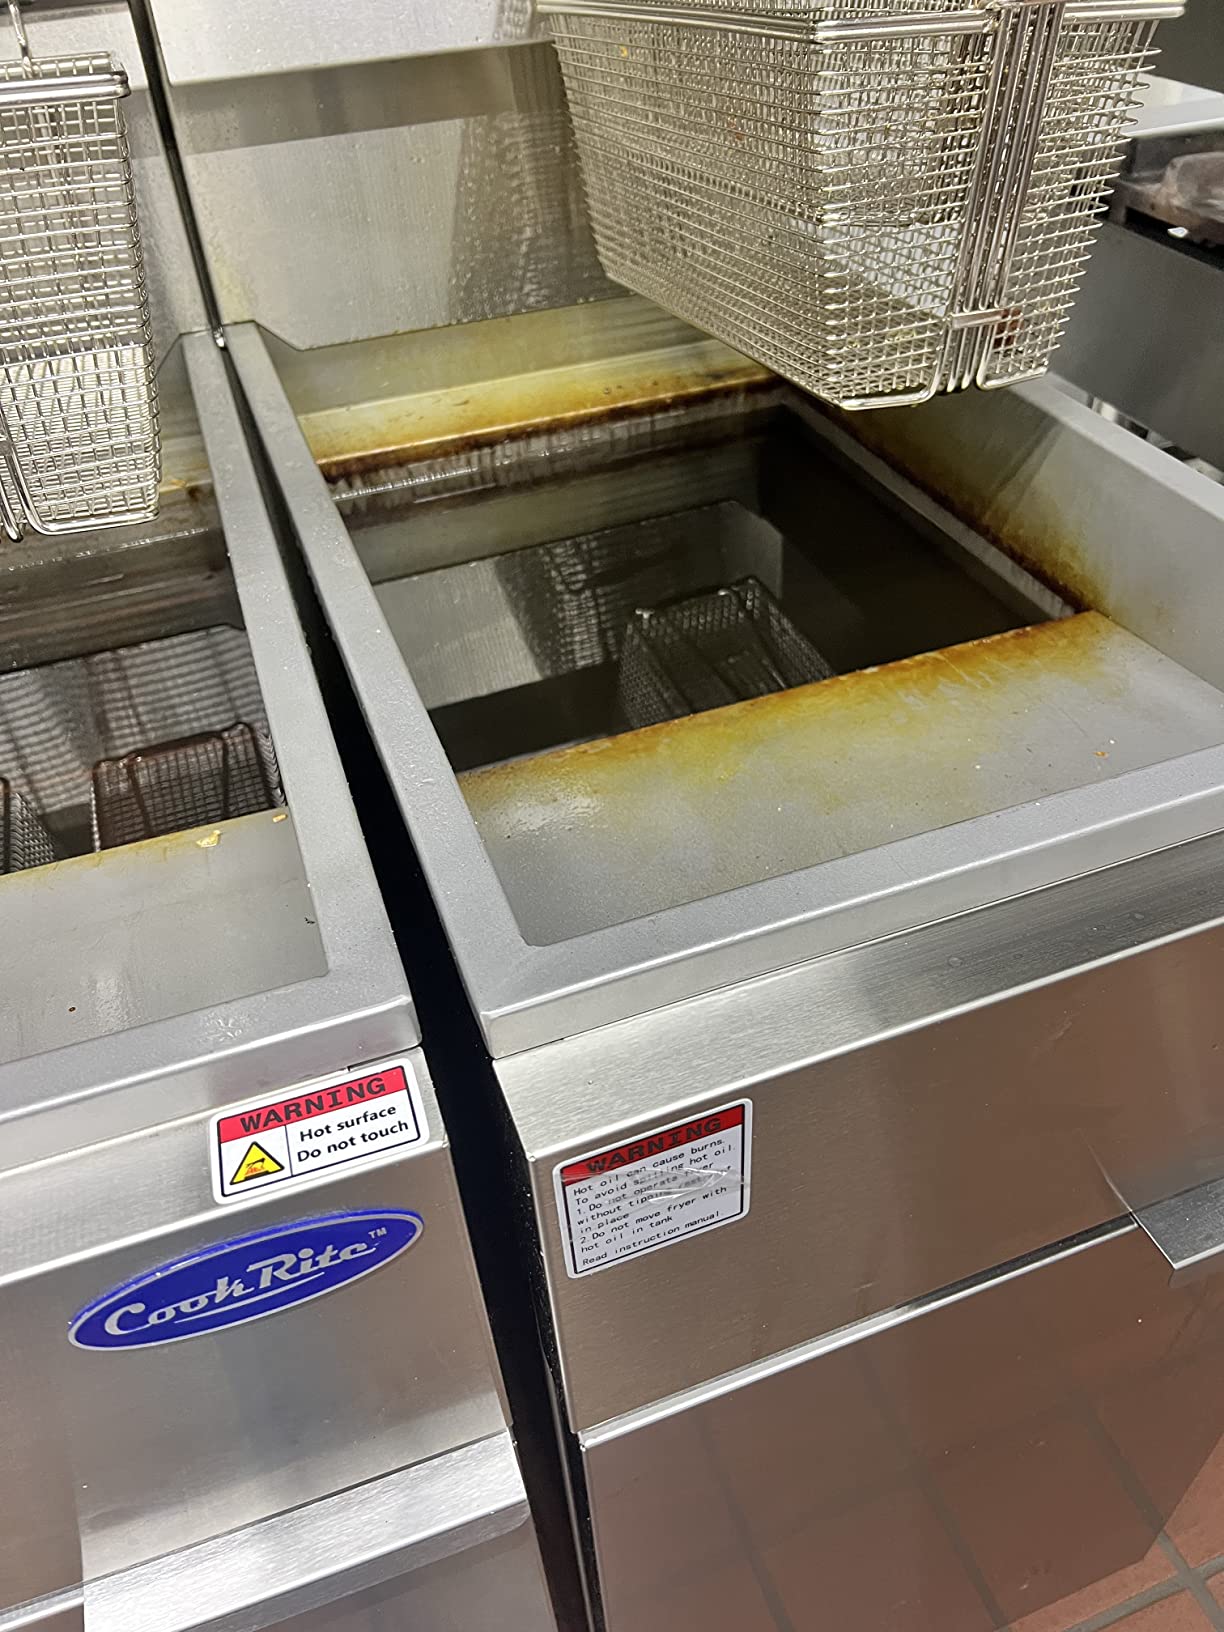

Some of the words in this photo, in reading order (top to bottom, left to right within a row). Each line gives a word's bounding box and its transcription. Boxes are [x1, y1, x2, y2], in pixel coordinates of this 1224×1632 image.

[240, 1077, 386, 1132] WARNING
[300, 1125, 332, 1142] Hot
[337, 1107, 397, 1130] surface
[298, 1149, 321, 1162] Do
[327, 1138, 356, 1153] not
[361, 1120, 409, 1142] touch
[586, 1118, 721, 1173] WARNING
[573, 1185, 593, 1195] Hot
[600, 1175, 619, 1186] oil
[627, 1166, 646, 1177] can
[653, 1152, 684, 1168] cause
[576, 1196, 590, 1205] To
[595, 1183, 627, 1199] avoid
[690, 1154, 707, 1165] hot
[578, 1205, 621, 1225] without
[581, 1226, 592, 1234] in
[598, 1213, 629, 1229] place
[611, 1223, 629, 1232] not
[636, 1211, 665, 1224] move
[668, 1198, 696, 1213] fryer
[703, 1187, 727, 1199] with
[581, 1243, 599, 1253] hot
[606, 1234, 623, 1244] oil
[633, 1227, 643, 1235] in
[650, 1216, 673, 1228] tank
[582, 1253, 607, 1265] Read
[615, 1227, 680, 1254] instruction
